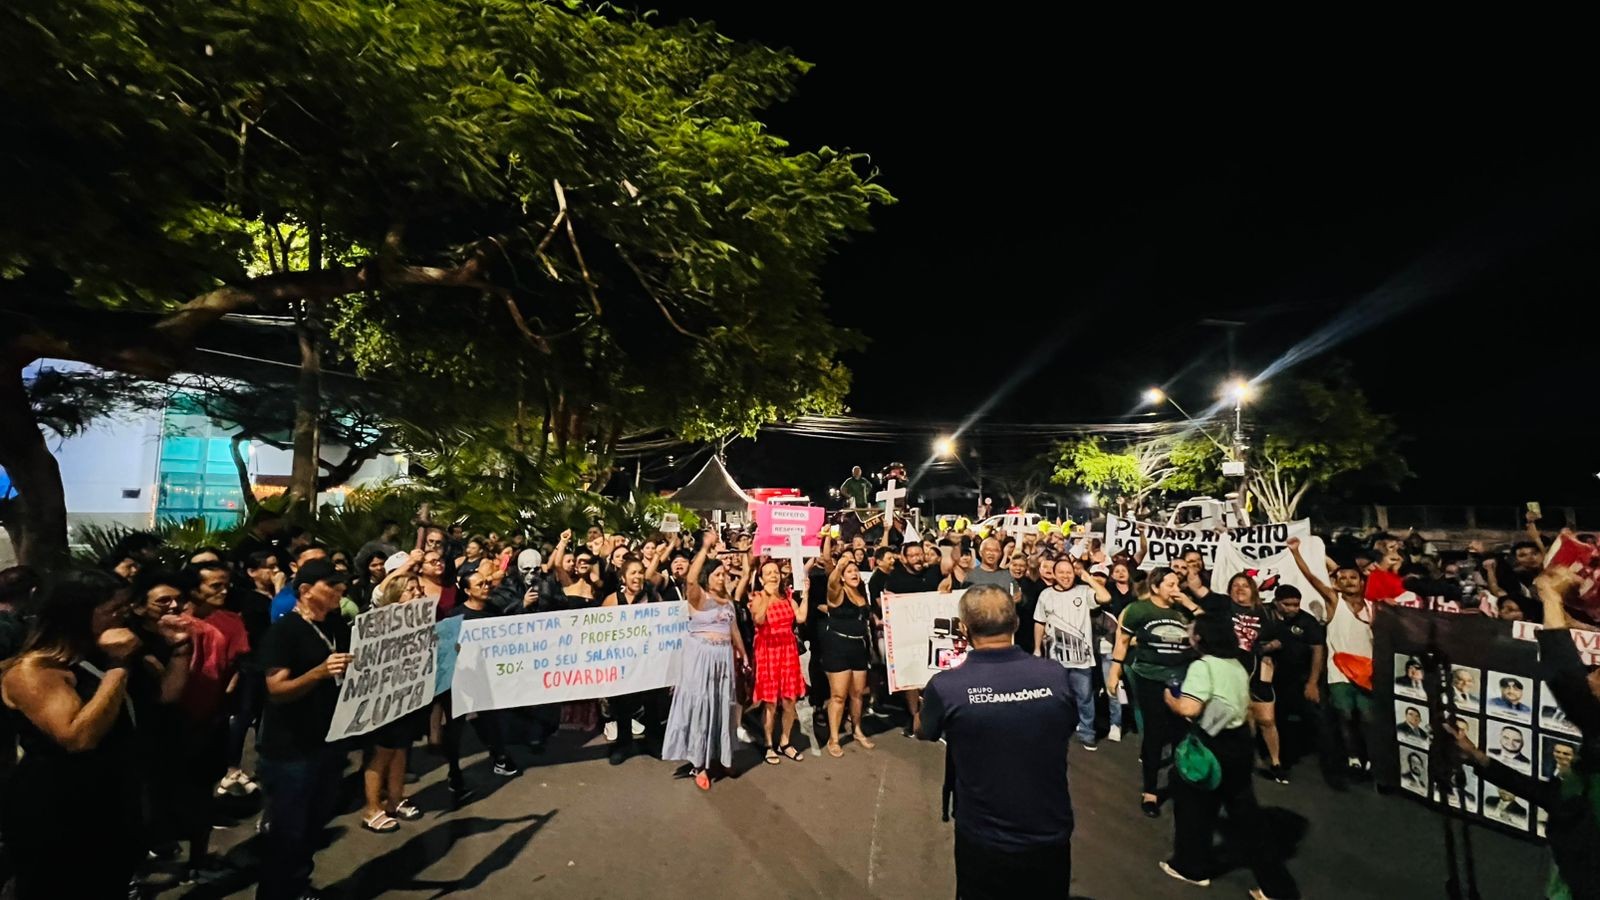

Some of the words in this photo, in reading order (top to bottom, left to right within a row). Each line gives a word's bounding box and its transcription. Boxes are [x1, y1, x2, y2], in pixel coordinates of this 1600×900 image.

[404, 601, 434, 628] QUE
[461, 617, 561, 643] ACRESCENTAR
[570, 615, 578, 626] 7
[583, 612, 613, 625] ANOS
[620, 611, 627, 621] A
[634, 607, 660, 619] MAIS
[668, 606, 679, 616] DE
[480, 640, 548, 658] TRABALHO
[559, 634, 573, 647] AO
[580, 625, 651, 644] PROFESSOR,
[496, 661, 524, 676] 30%
[534, 658, 549, 670] DO
[555, 653, 577, 666] SEU
[585, 646, 637, 662] SALÁRIO,
[643, 641, 648, 654] É
[658, 638, 682, 651] UMA
[543, 665, 625, 689] COVARDIA!
[344, 681, 425, 735] LUTA
[968, 687, 1053, 704] REDEAMAZÔNICA
